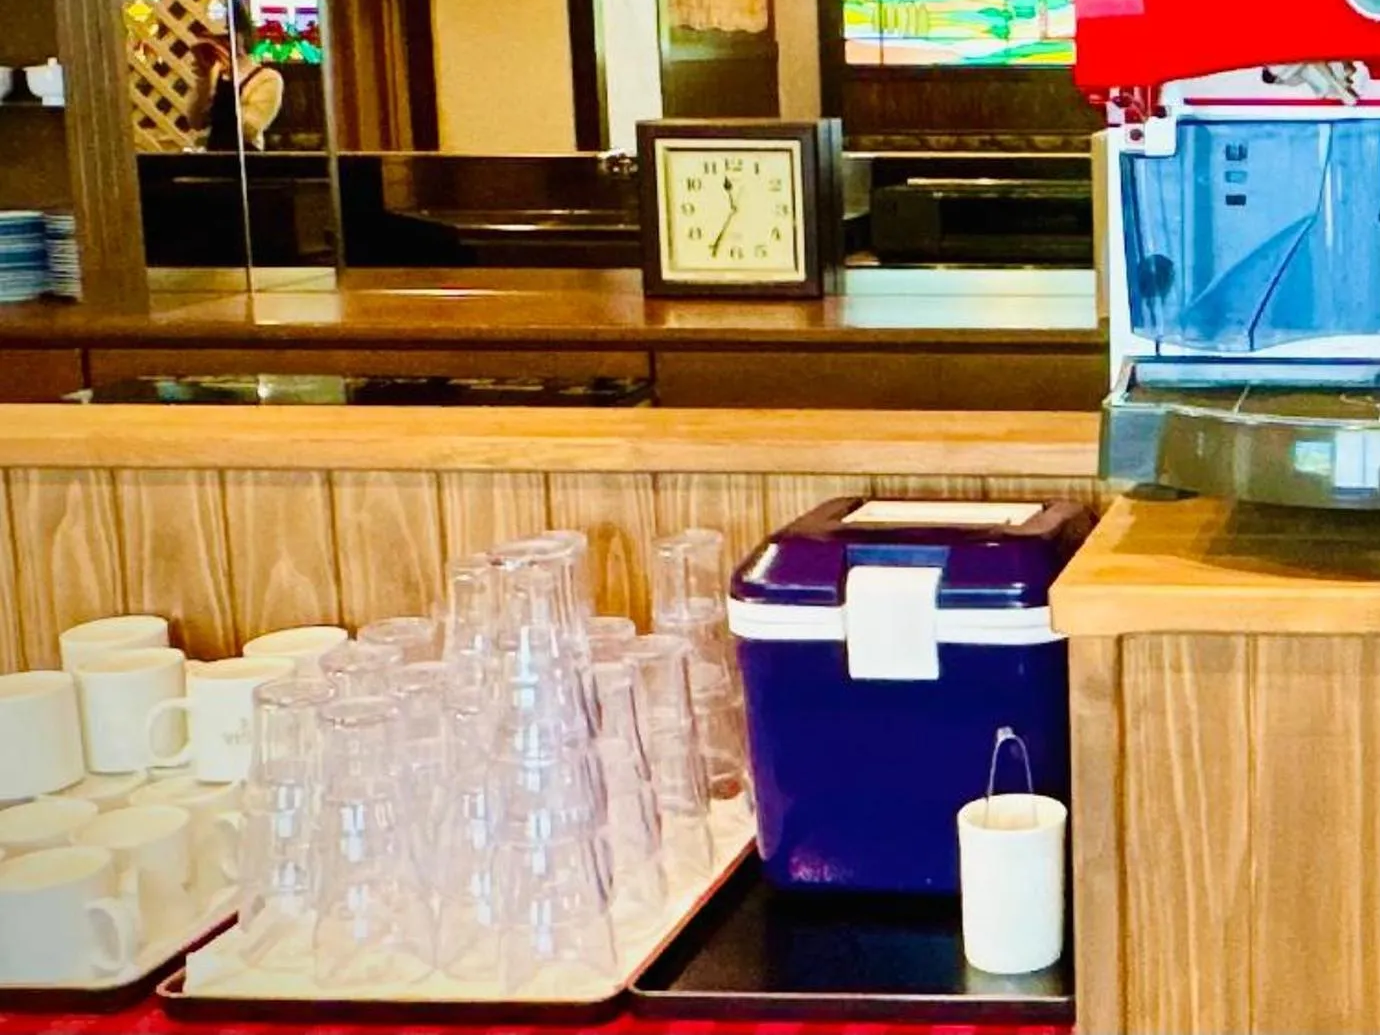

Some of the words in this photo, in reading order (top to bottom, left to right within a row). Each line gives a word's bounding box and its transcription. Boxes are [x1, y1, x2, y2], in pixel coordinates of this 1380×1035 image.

[703, 161, 718, 175] 11
[724, 158, 743, 172] 12
[753, 162, 760, 175] 1
[686, 177, 702, 192] 10
[768, 178, 782, 192] 2
[681, 203, 695, 215] 9
[776, 204, 789, 216] 3
[688, 227, 702, 240] 8
[771, 227, 781, 241] 4
[729, 246, 744, 259] 6
[754, 244, 767, 258] 5
